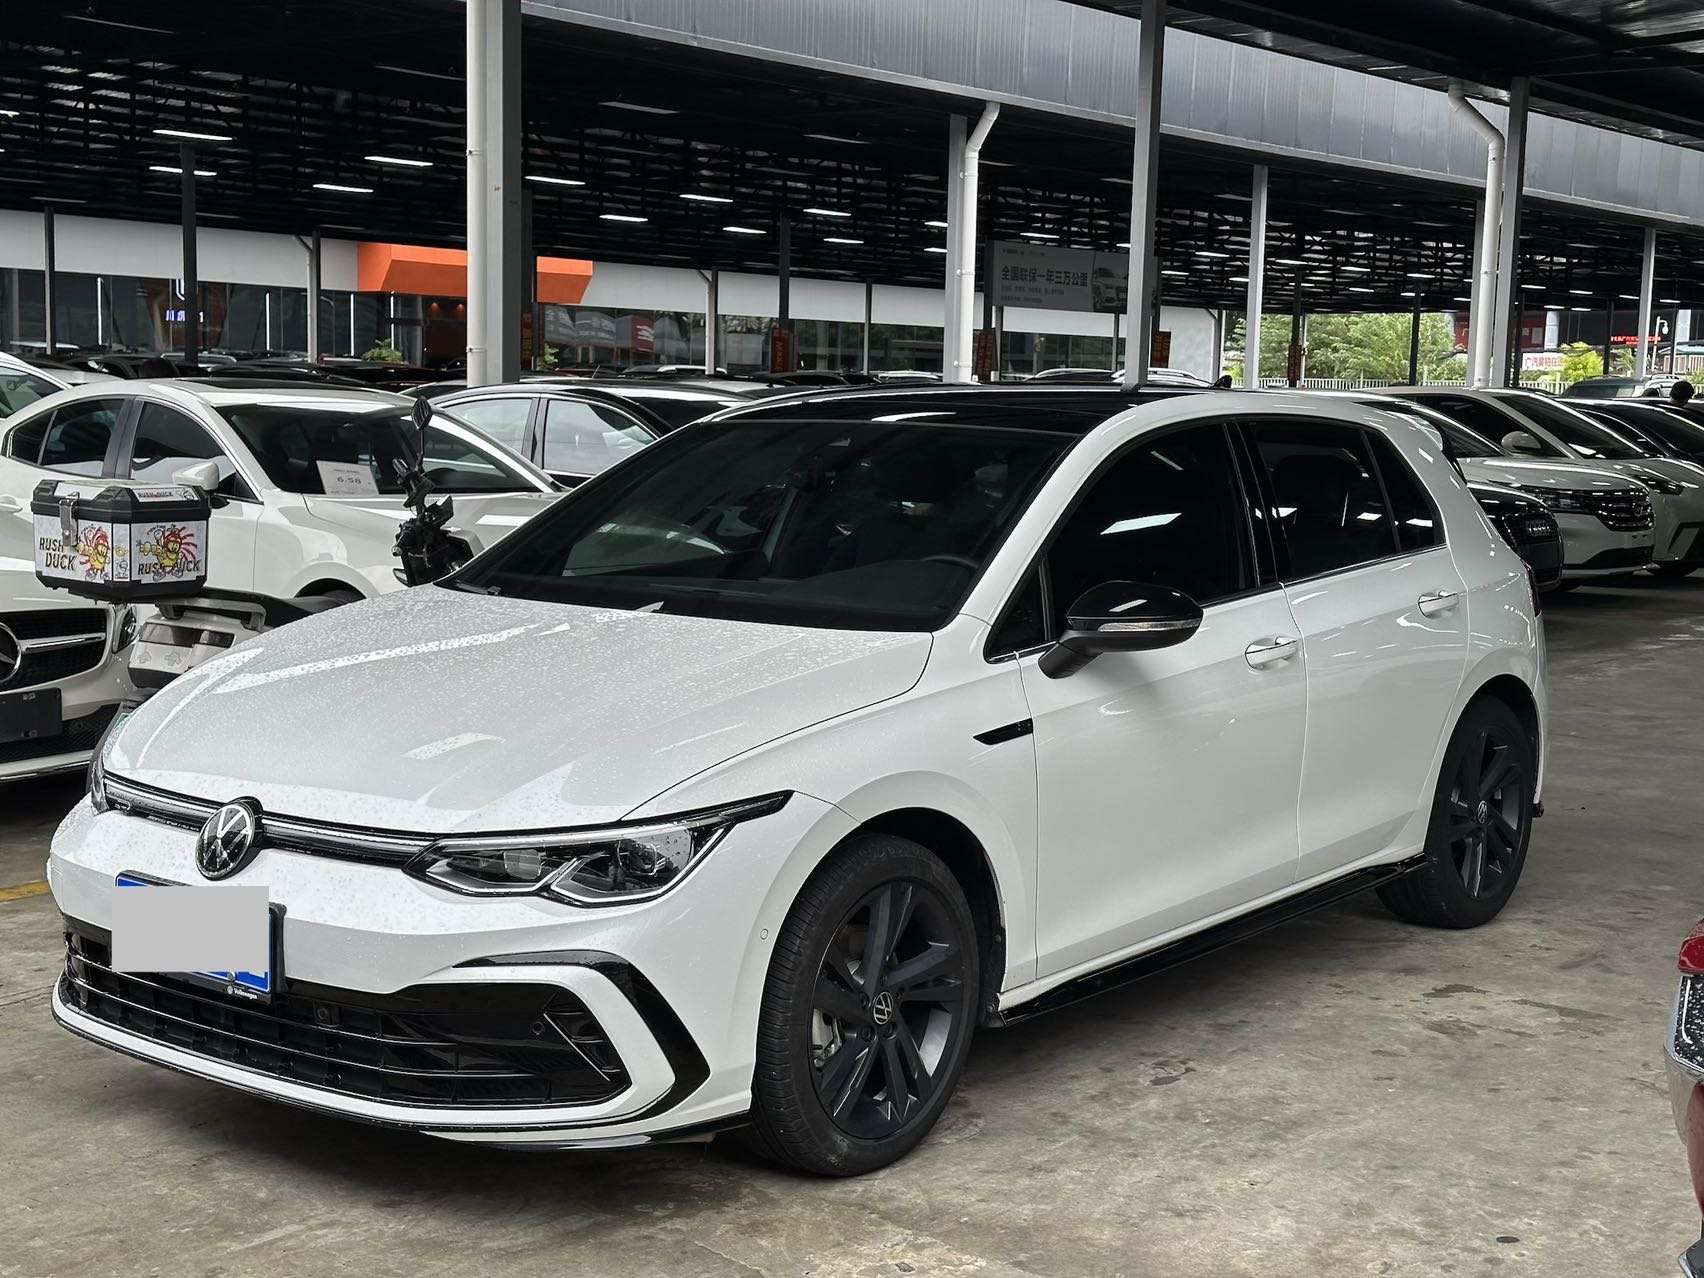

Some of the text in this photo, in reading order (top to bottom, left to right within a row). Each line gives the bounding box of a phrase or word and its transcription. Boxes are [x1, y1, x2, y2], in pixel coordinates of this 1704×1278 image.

[1001, 265, 1088, 287] 全国联保一年三万公里
[45, 552, 77, 571] DUCK
